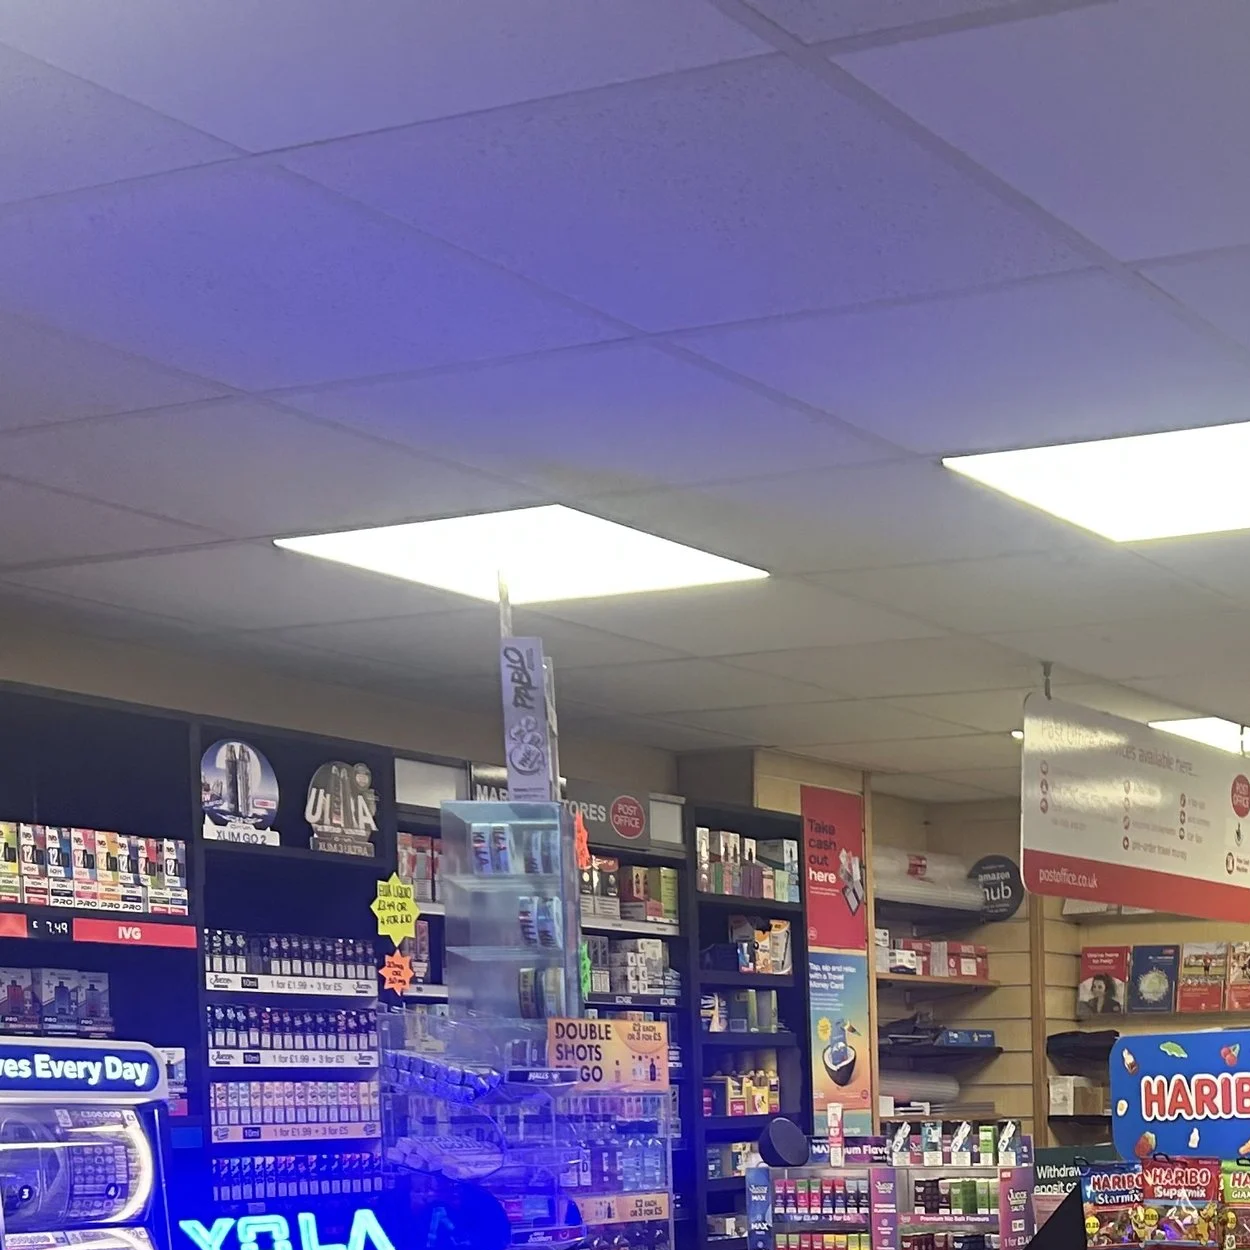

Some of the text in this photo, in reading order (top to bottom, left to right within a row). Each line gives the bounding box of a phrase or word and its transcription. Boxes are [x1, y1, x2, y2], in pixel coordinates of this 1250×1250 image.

[618, 804, 637, 816] POST
[613, 815, 640, 828] OFFICE
[808, 819, 835, 834] Take
[808, 837, 836, 850] cash
[808, 855, 828, 866] out
[809, 868, 836, 883] here
[1039, 867, 1098, 888] postoffice.co.uk
[53, 899, 73, 907] PRO
[101, 902, 120, 910] PRO
[122, 903, 142, 911] PRO
[118, 927, 141, 939] IVG
[556, 1022, 611, 1040] DOUBLE
[556, 1044, 602, 1061] SHOTS
[34, 1054, 102, 1085] Every
[104, 1056, 149, 1087] Day
[580, 1065, 602, 1082] GO
[1091, 1174, 1142, 1192] HARIBO
[1151, 1168, 1211, 1186] HARIBO
[22, 1188, 29, 1199] 3
[108, 1186, 116, 1196] 4
[1098, 1190, 1142, 1205] Starmix
